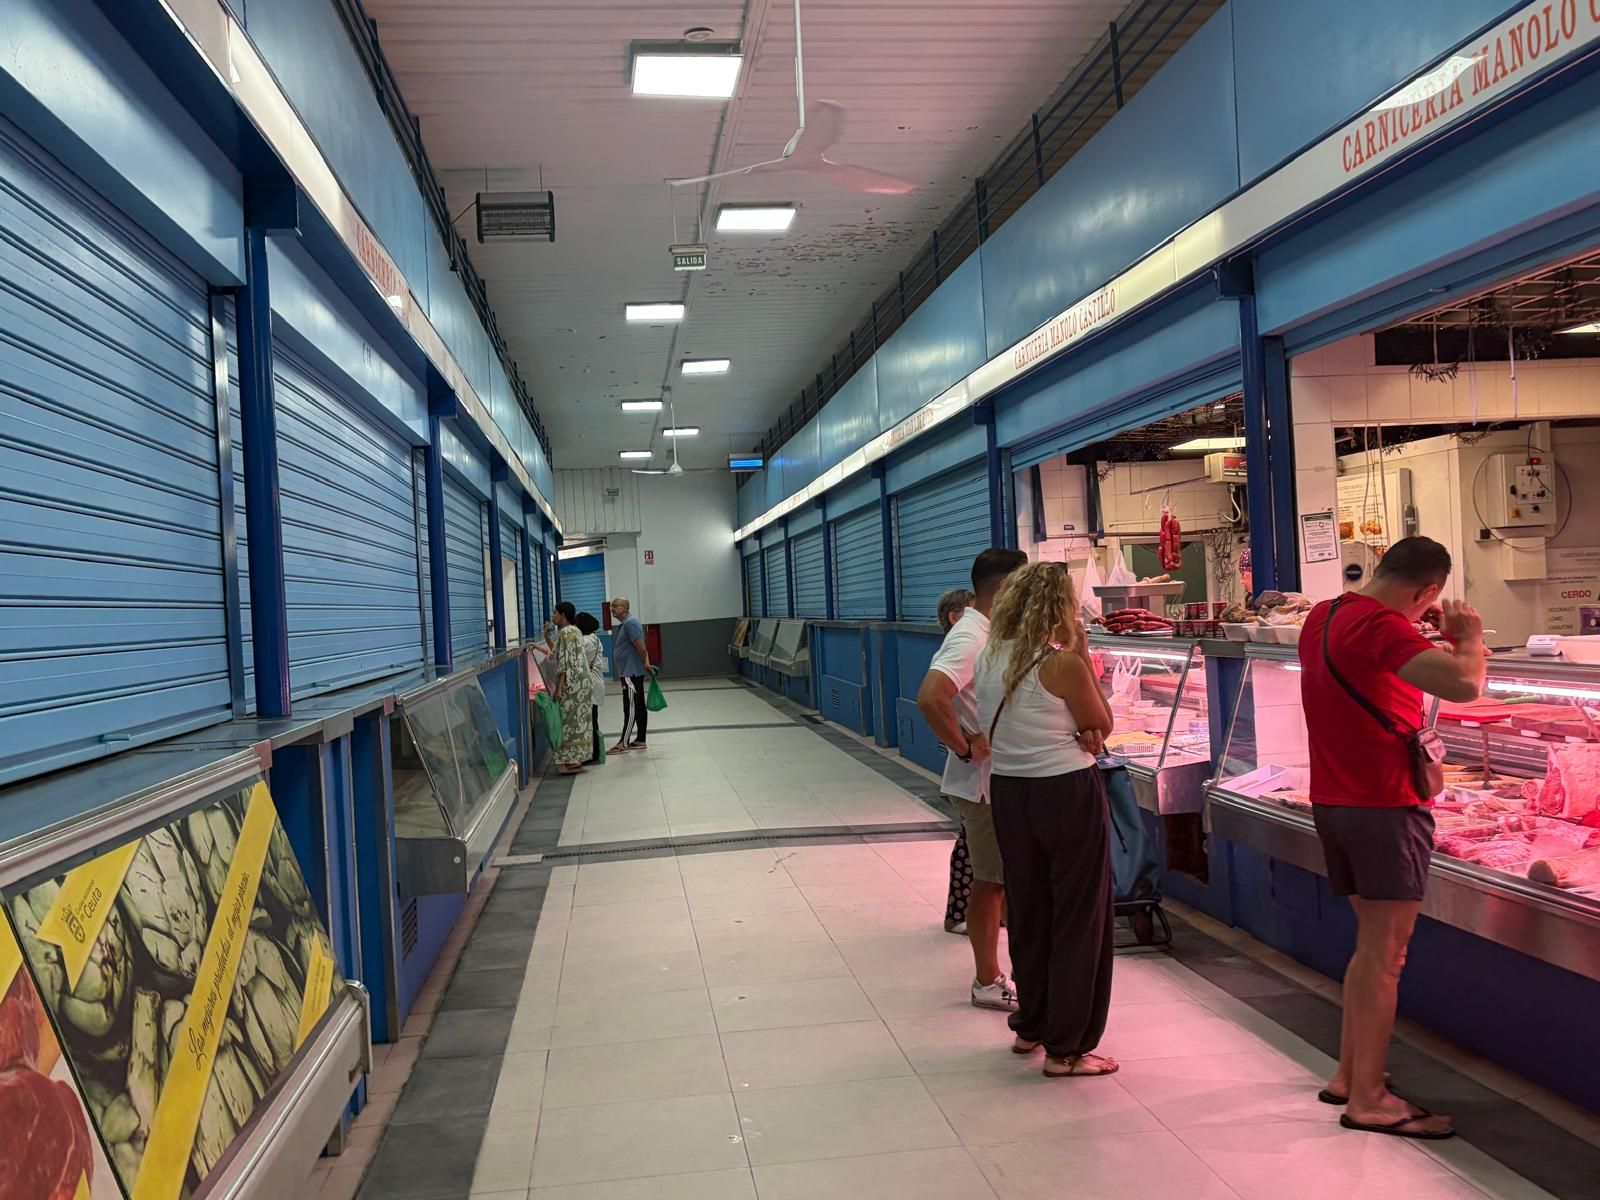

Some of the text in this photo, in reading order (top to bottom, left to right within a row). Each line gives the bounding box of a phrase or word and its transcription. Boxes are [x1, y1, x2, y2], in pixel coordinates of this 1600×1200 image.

[1472, 0, 1576, 96] MANOLO
[676, 256, 703, 265] SALIDA
[1050, 312, 1077, 349] MANOLO
[1080, 288, 1116, 331] CASTILLO
[1561, 590, 1592, 599] CERDO
[84, 887, 102, 918] Ceuta
